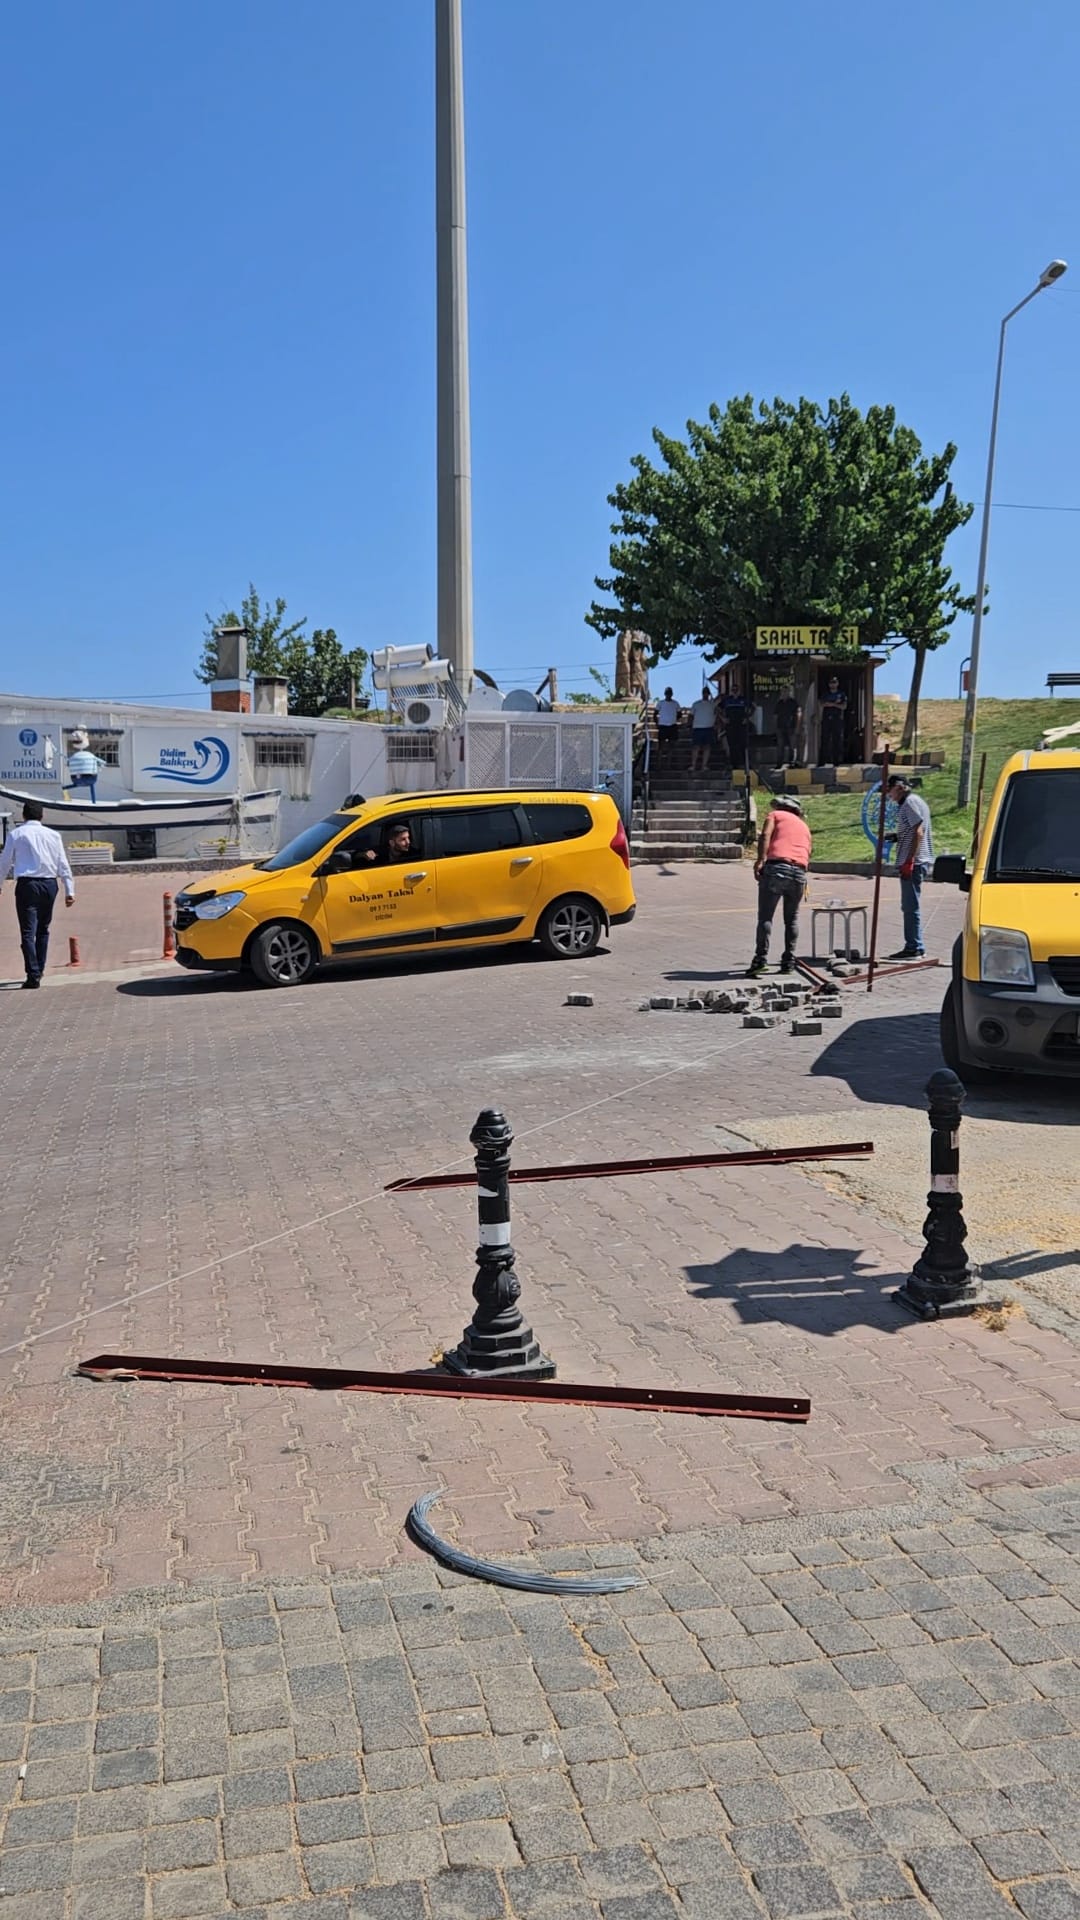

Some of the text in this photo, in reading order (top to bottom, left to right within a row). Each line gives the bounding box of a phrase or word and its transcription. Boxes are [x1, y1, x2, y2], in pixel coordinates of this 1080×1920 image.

[810, 630, 854, 645] TASi
[160, 748, 186, 757] Didim
[1, 770, 57, 779] BELEDİYESİ
[349, 888, 414, 903] Dalyan Taksi
